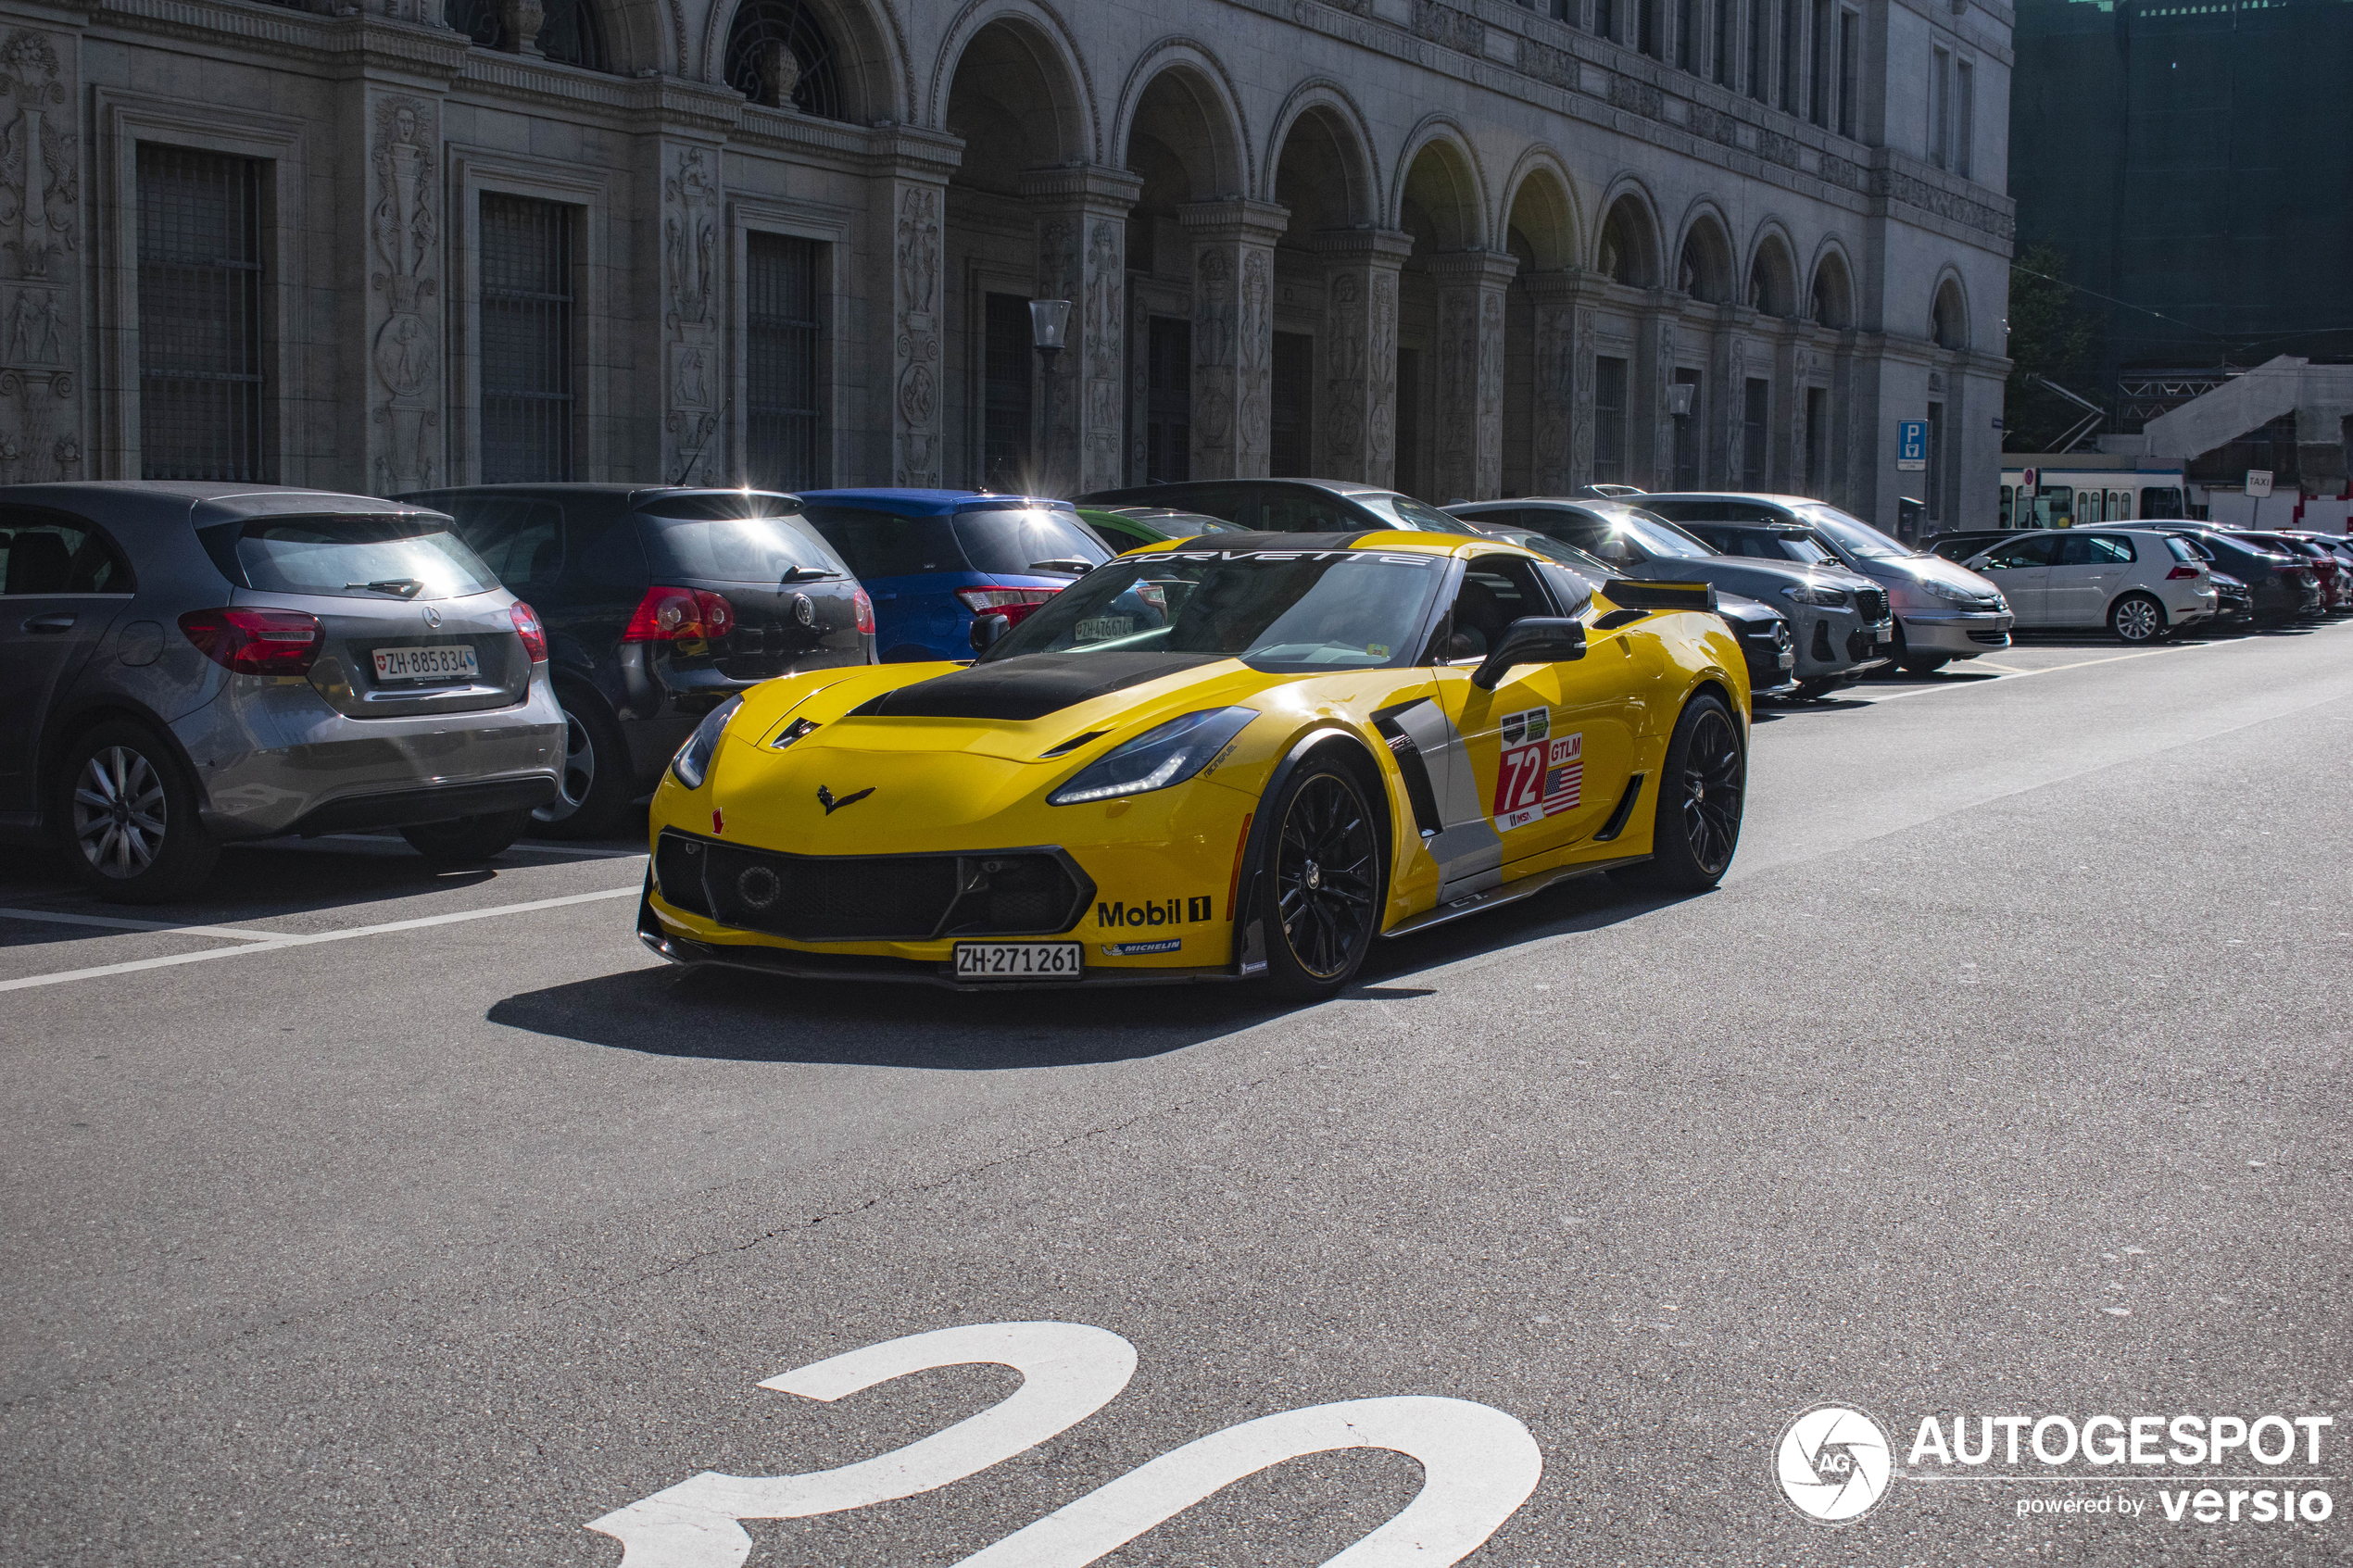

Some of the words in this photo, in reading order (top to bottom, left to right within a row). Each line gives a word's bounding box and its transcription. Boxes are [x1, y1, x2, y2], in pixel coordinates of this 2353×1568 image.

[1907, 424, 1919, 443] P
[2249, 477, 2270, 486] TAXI
[1106, 550, 1436, 566] CORVETTE
[1551, 737, 1580, 762] GTLM
[1504, 746, 1541, 810] 72
[1097, 898, 1181, 927] Mobil
[1125, 941, 1181, 952] MICHELIN
